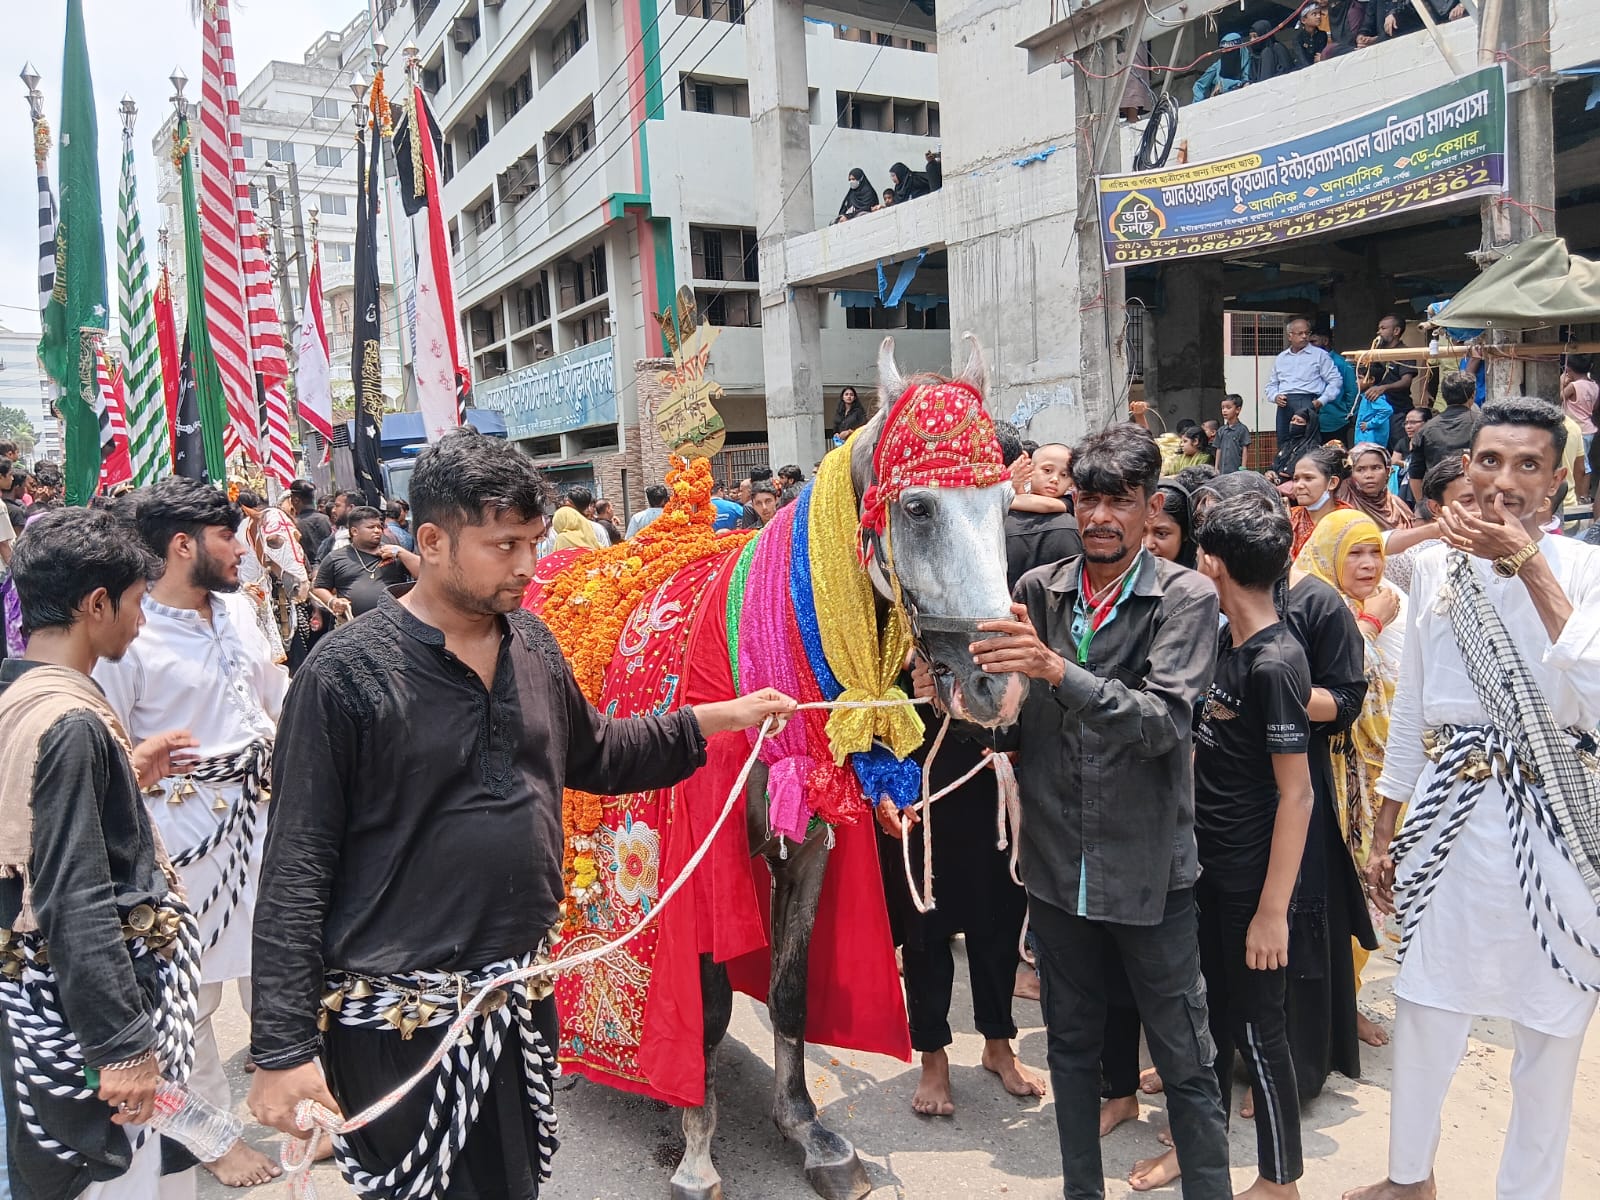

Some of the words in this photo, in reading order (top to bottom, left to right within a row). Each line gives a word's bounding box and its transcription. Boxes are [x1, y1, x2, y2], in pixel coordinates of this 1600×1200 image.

[1161, 177, 1229, 207] আনওয়ারুল
[1229, 164, 1278, 204] কুরআন
[1277, 134, 1371, 186] ইন্টারন্যাশনাল
[1372, 115, 1424, 153] বালিকা
[1426, 89, 1489, 136] মাদরাসা
[1192, 168, 1209, 177] জন্য
[1211, 162, 1236, 174] বিশেষ
[1248, 191, 1298, 212] আবাসিক
[1319, 164, 1385, 193] অনাবাসিক
[1410, 130, 1480, 166] ডে-কেয়ার
[1121, 203, 1151, 221] ভর্তি
[1286, 169, 1491, 237] 01924-774362
[1119, 219, 1155, 235] চলছে
